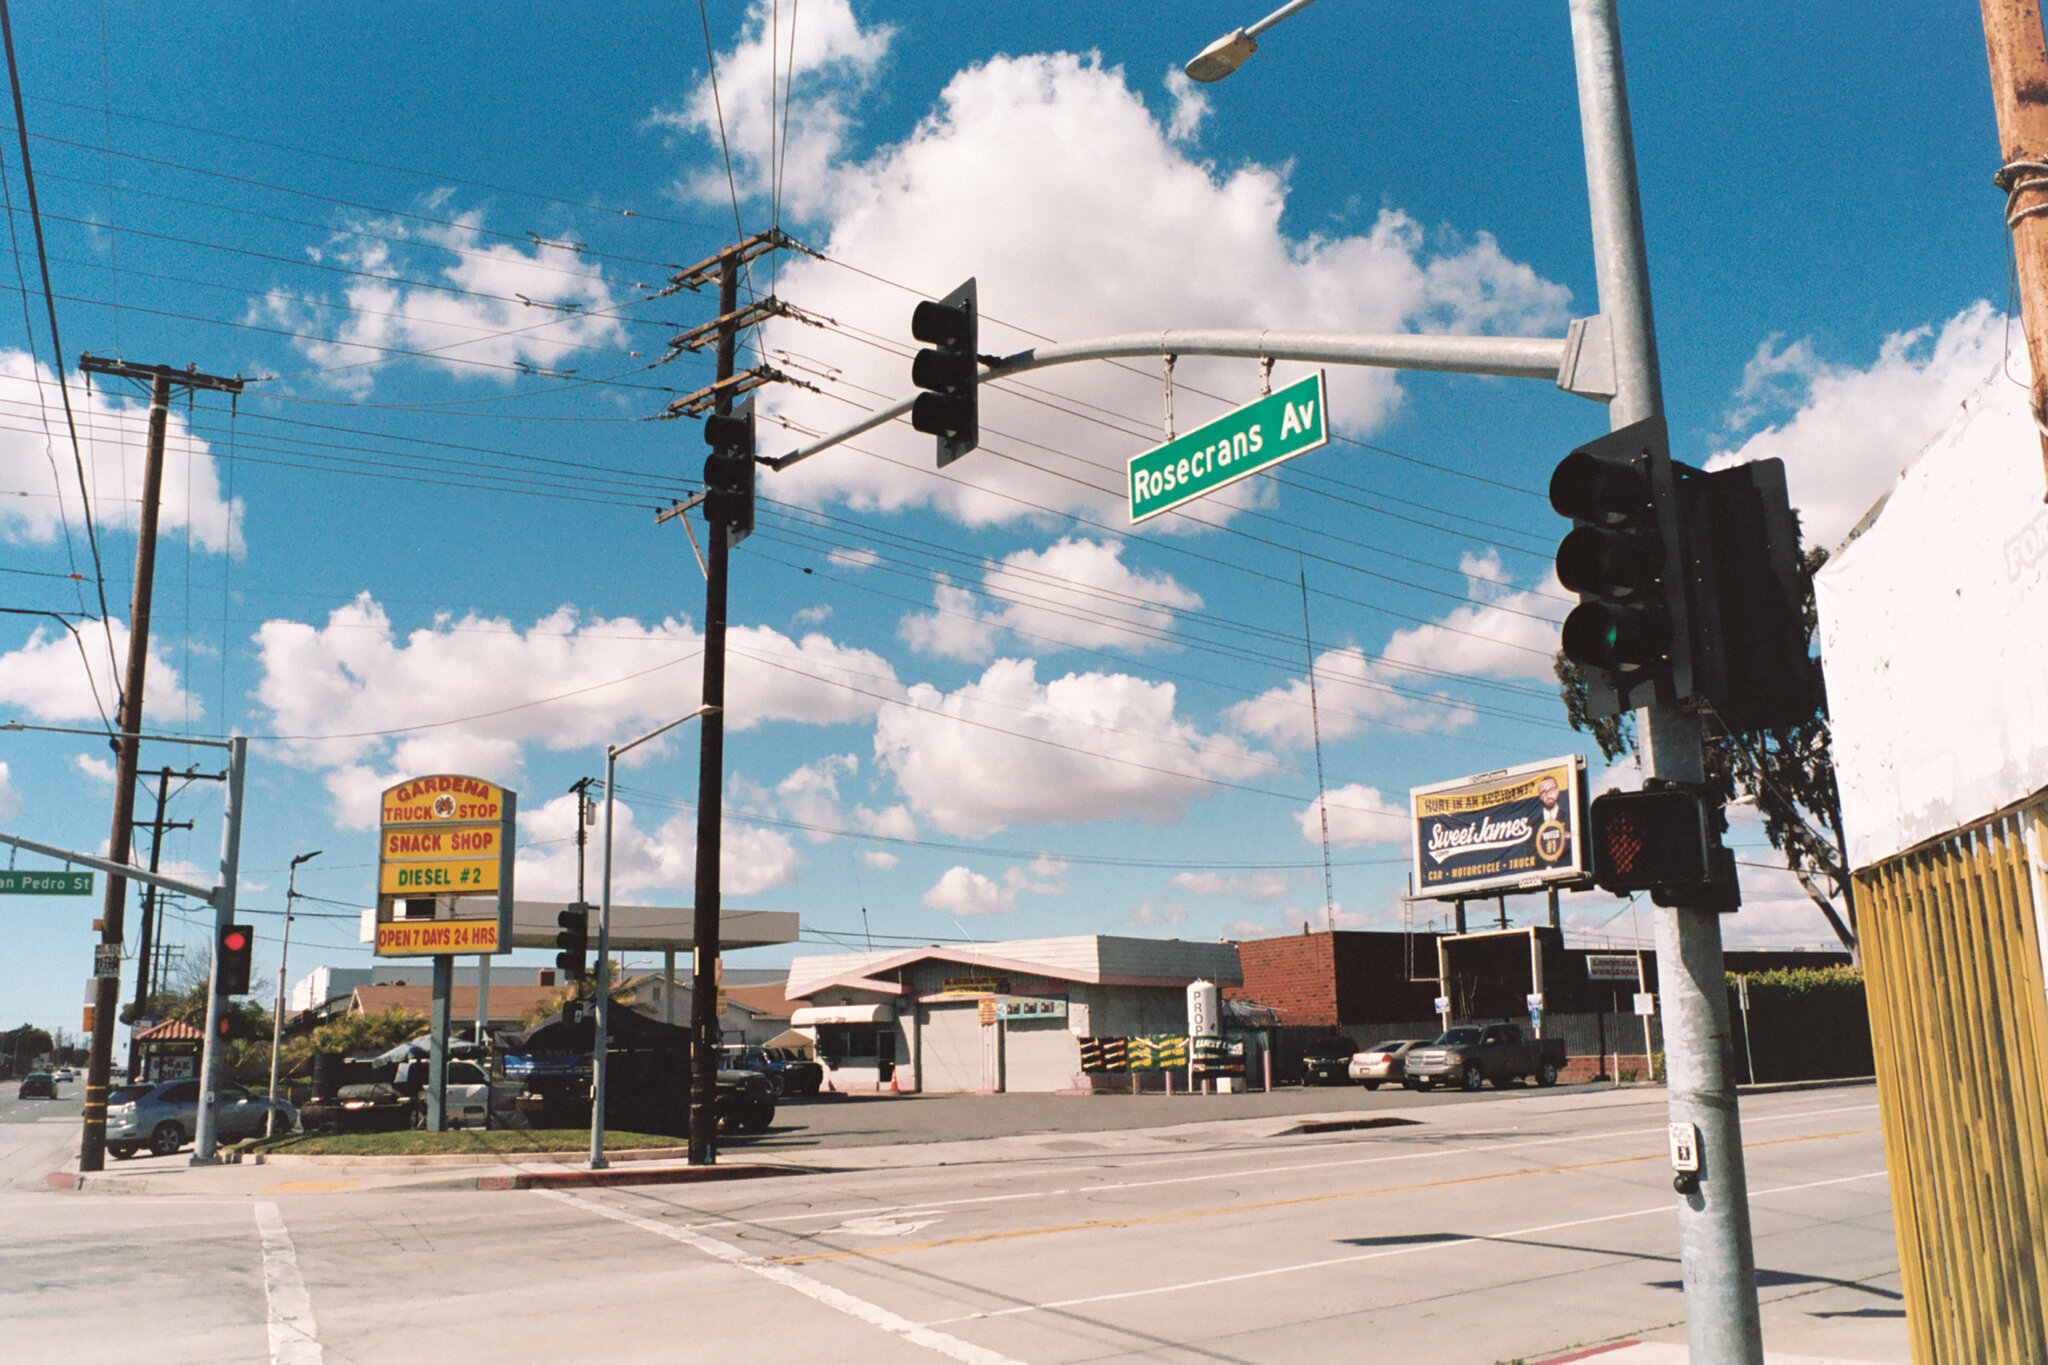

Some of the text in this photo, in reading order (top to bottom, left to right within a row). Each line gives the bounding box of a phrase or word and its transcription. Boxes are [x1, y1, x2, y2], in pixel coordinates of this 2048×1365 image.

[1134, 400, 1314, 503] Rosecrans Av
[397, 777, 489, 802] GARDENA
[384, 803, 498, 821] TRUCK STOP
[1425, 799, 1449, 813] HURT
[1453, 799, 1464, 810] IN
[1466, 797, 1479, 809] AN
[389, 832, 493, 853] SNACK SHOP
[1428, 816, 1530, 850] Sweet James
[398, 868, 451, 886] DIESEL
[1428, 856, 1536, 881] CAR MOTORCYCLE TRUCK
[22, 876, 66, 890] Pedro
[73, 877, 91, 890] St
[379, 926, 497, 947] OPEN 7 DAYS 24 HRS.
